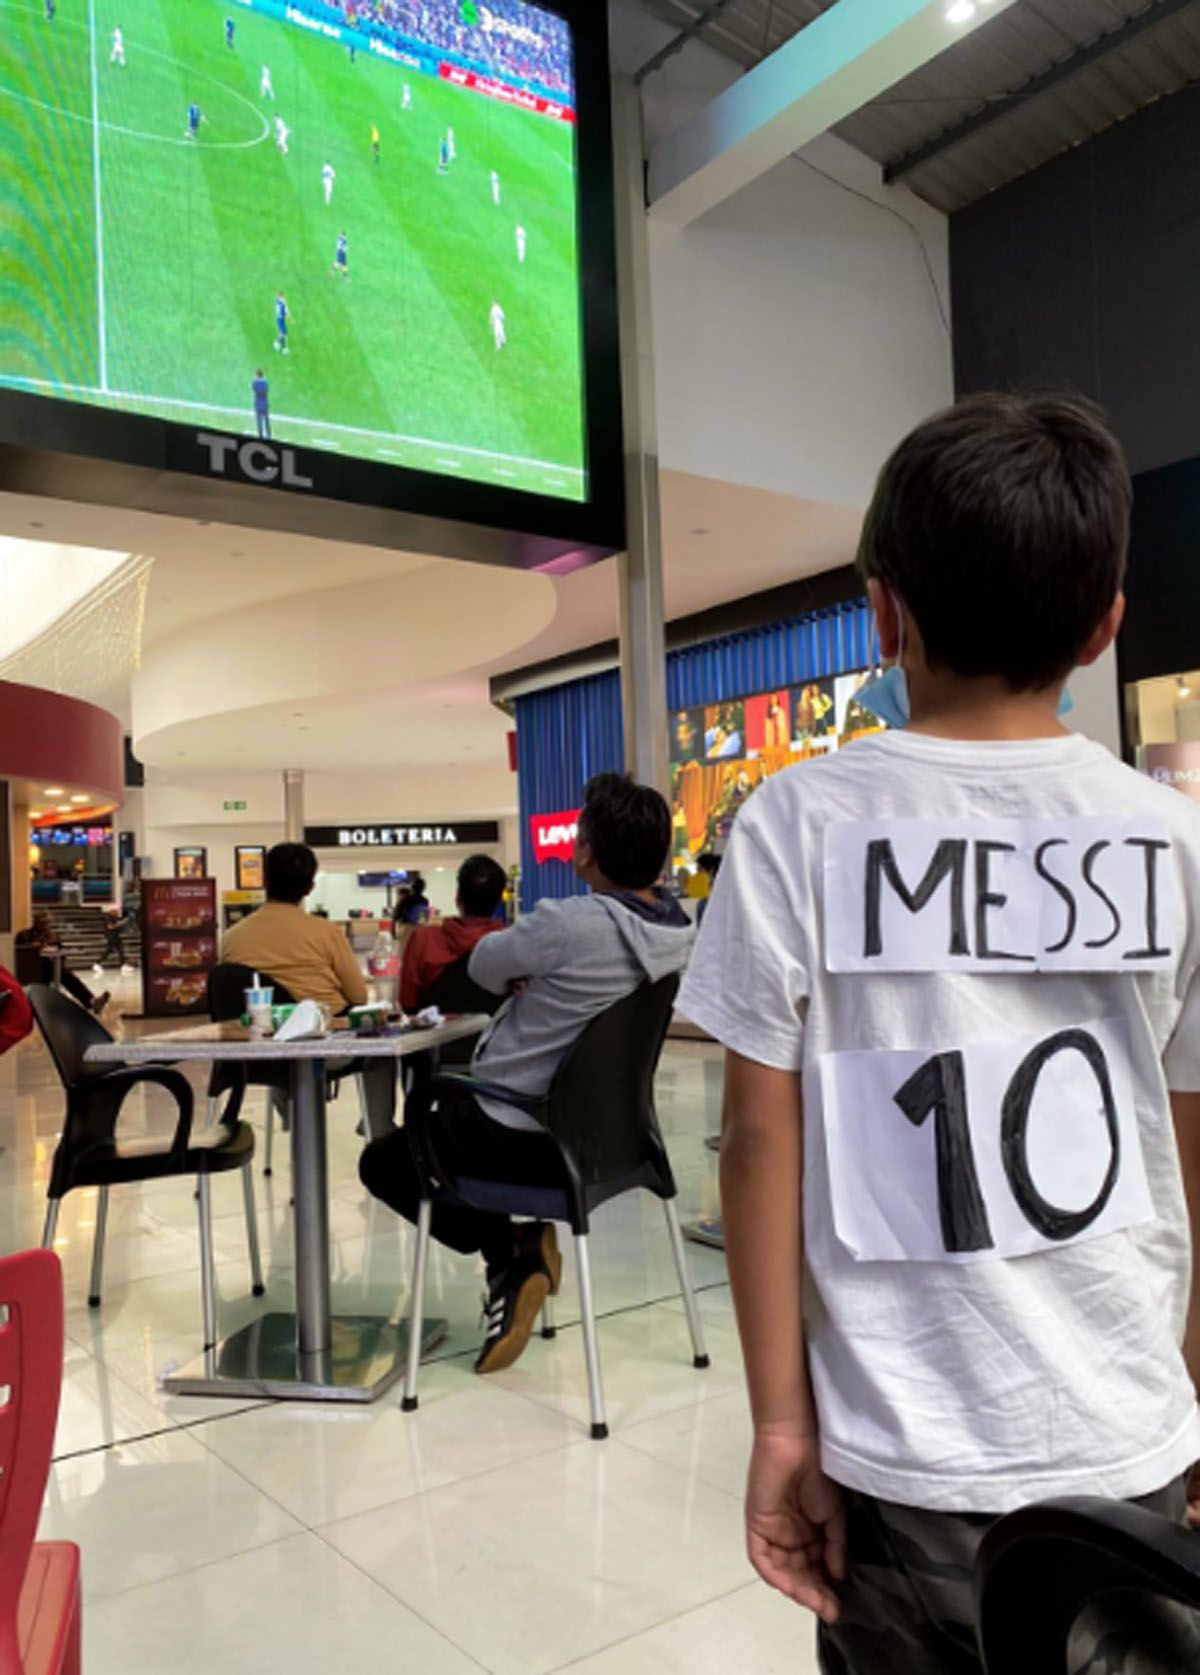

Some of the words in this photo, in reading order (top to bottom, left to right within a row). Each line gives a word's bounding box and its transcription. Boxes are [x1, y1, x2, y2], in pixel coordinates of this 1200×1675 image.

[197, 433, 313, 488] TCL
[338, 827, 457, 845] BOLETERIA
[864, 838, 1171, 962] MESSI
[893, 1028, 1120, 1253] 10
